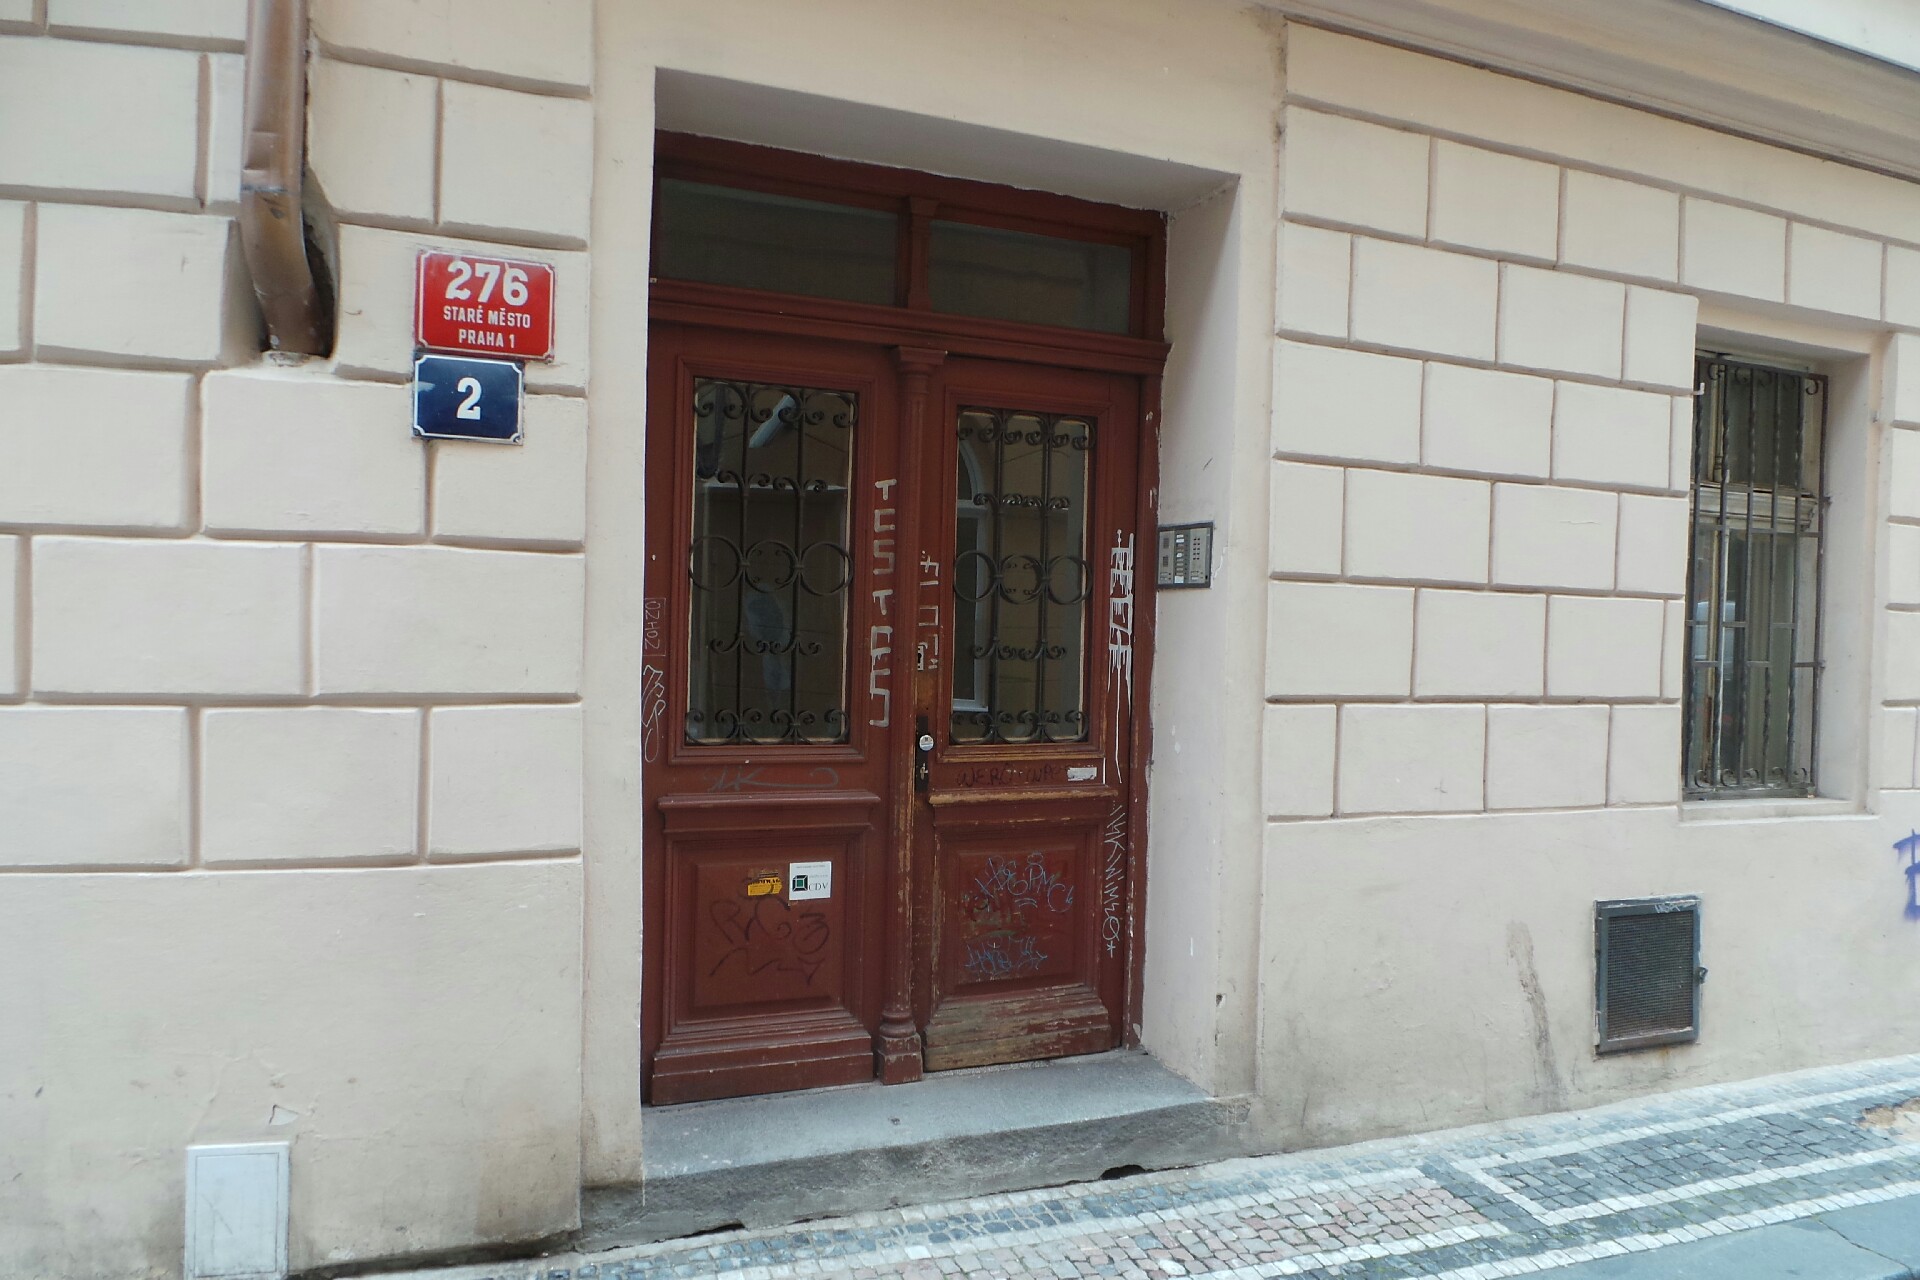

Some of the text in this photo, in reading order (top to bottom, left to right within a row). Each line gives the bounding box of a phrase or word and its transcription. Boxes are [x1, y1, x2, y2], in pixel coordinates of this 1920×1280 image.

[445, 260, 529, 307] 276
[443, 304, 531, 329] STARÉ MĚSTO
[458, 328, 516, 349] PRAHA 1
[456, 377, 482, 420] 2
[808, 881, 829, 892] CDV
